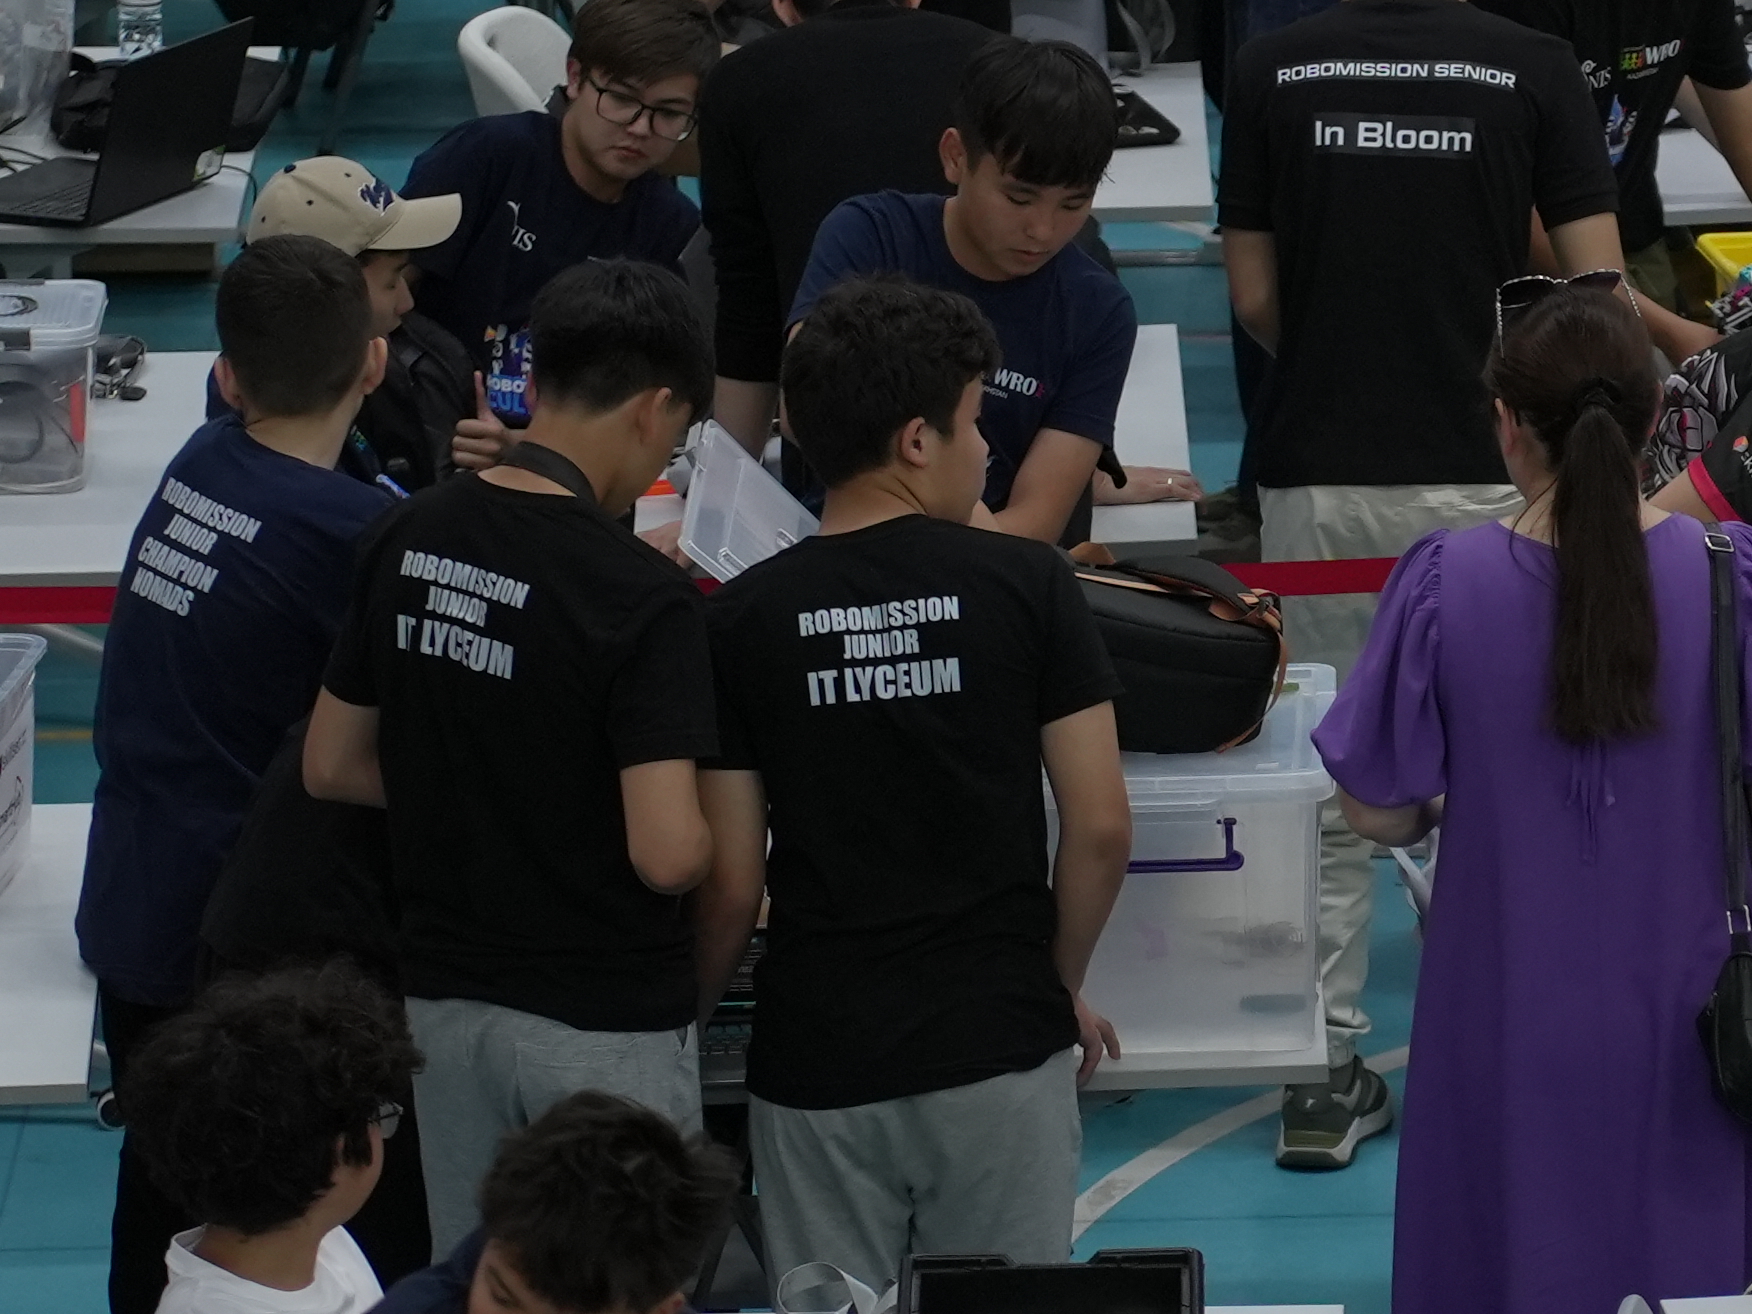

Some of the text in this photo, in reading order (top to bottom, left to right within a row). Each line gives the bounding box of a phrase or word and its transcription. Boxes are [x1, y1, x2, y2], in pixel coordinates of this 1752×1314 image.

[1276, 61, 1518, 90] ROBOMISSION SENIOR
[1313, 119, 1474, 154] In Bloom
[994, 367, 1038, 396] WRO
[161, 476, 262, 544] ROBOMISSION
[163, 513, 219, 556] JUNIOR
[137, 535, 220, 594] CHAMPION
[400, 549, 531, 610] ROBOMISSION
[129, 567, 195, 617] NOMADS
[424, 585, 488, 628] JUNIOR
[797, 595, 961, 638] ROBOMISSION
[396, 612, 515, 680] IT LYCEUM
[842, 628, 921, 660] JUNIOR
[806, 657, 962, 707] IT LYCEUM
